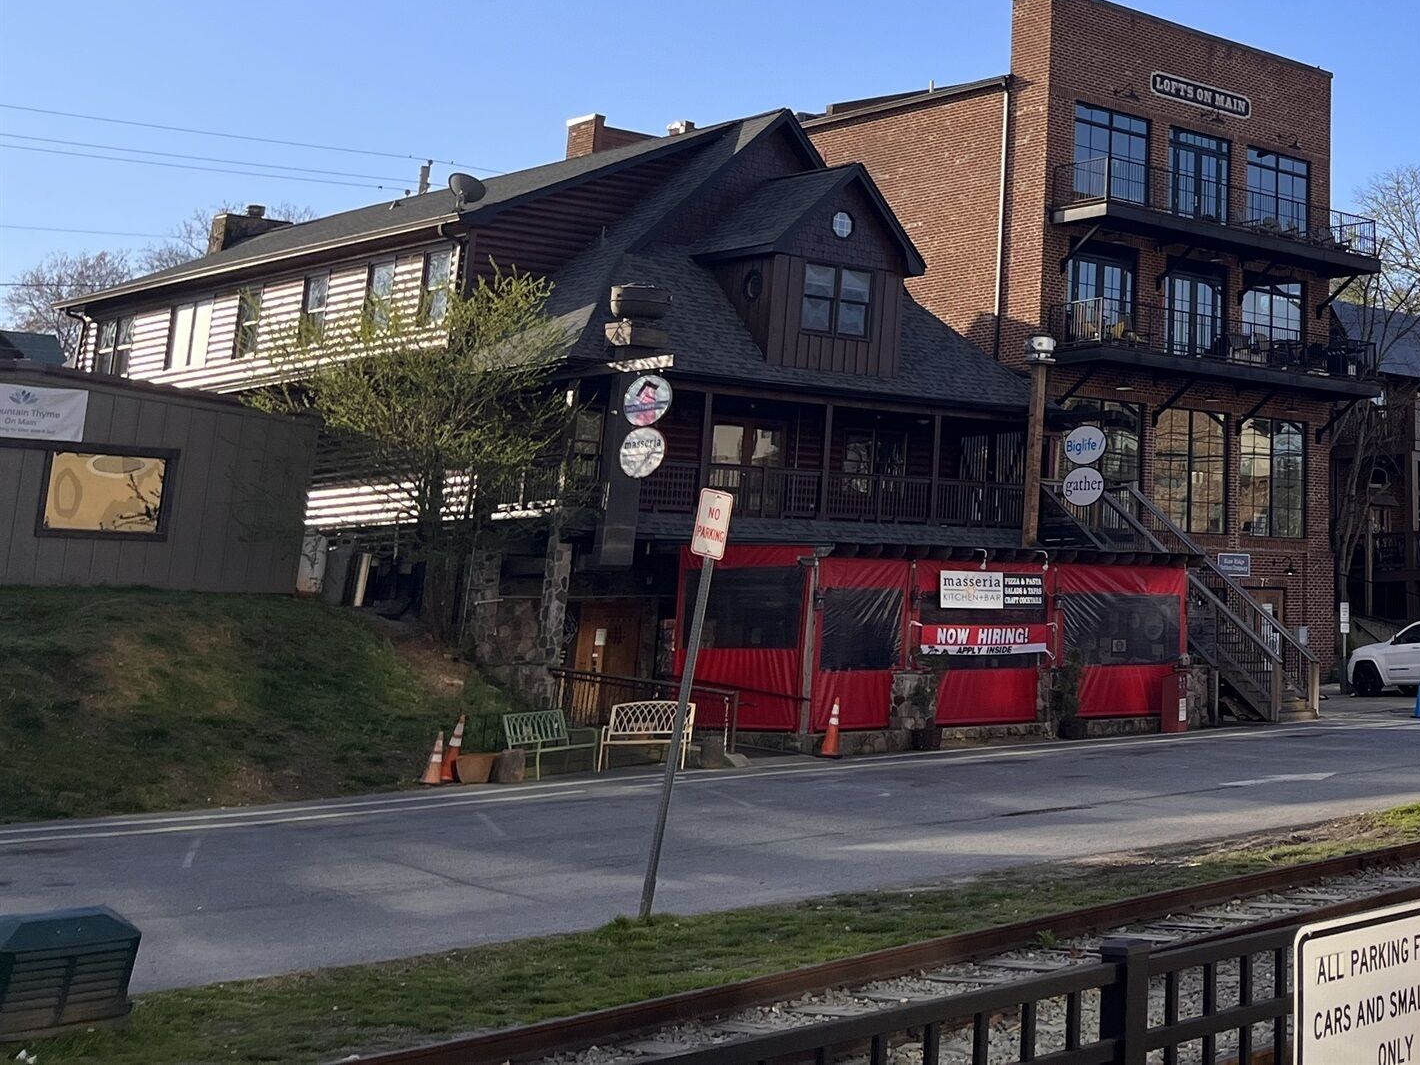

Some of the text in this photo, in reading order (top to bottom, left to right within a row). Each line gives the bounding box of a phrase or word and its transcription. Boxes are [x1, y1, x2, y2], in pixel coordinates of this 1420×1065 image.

[1156, 76, 1246, 112] LOFTS ON MAIN
[18, 418, 37, 426] Main
[32, 409, 61, 419] Thyme
[1066, 437, 1097, 455] Biglife
[1065, 476, 1103, 497] gather
[708, 506, 721, 521] NO
[695, 525, 725, 543] PARKING
[943, 575, 1001, 588] masseria
[1005, 577, 1020, 585] PIZZA
[937, 627, 1029, 645] NOW HIRING!
[956, 646, 1012, 654] APPLY INSIDE
[1317, 952, 1345, 985] ALL
[1350, 937, 1409, 977] PARKING
[1314, 1003, 1351, 1040] CARS
[1356, 995, 1385, 1028] AND
[1378, 1034, 1414, 1065] ONLY
